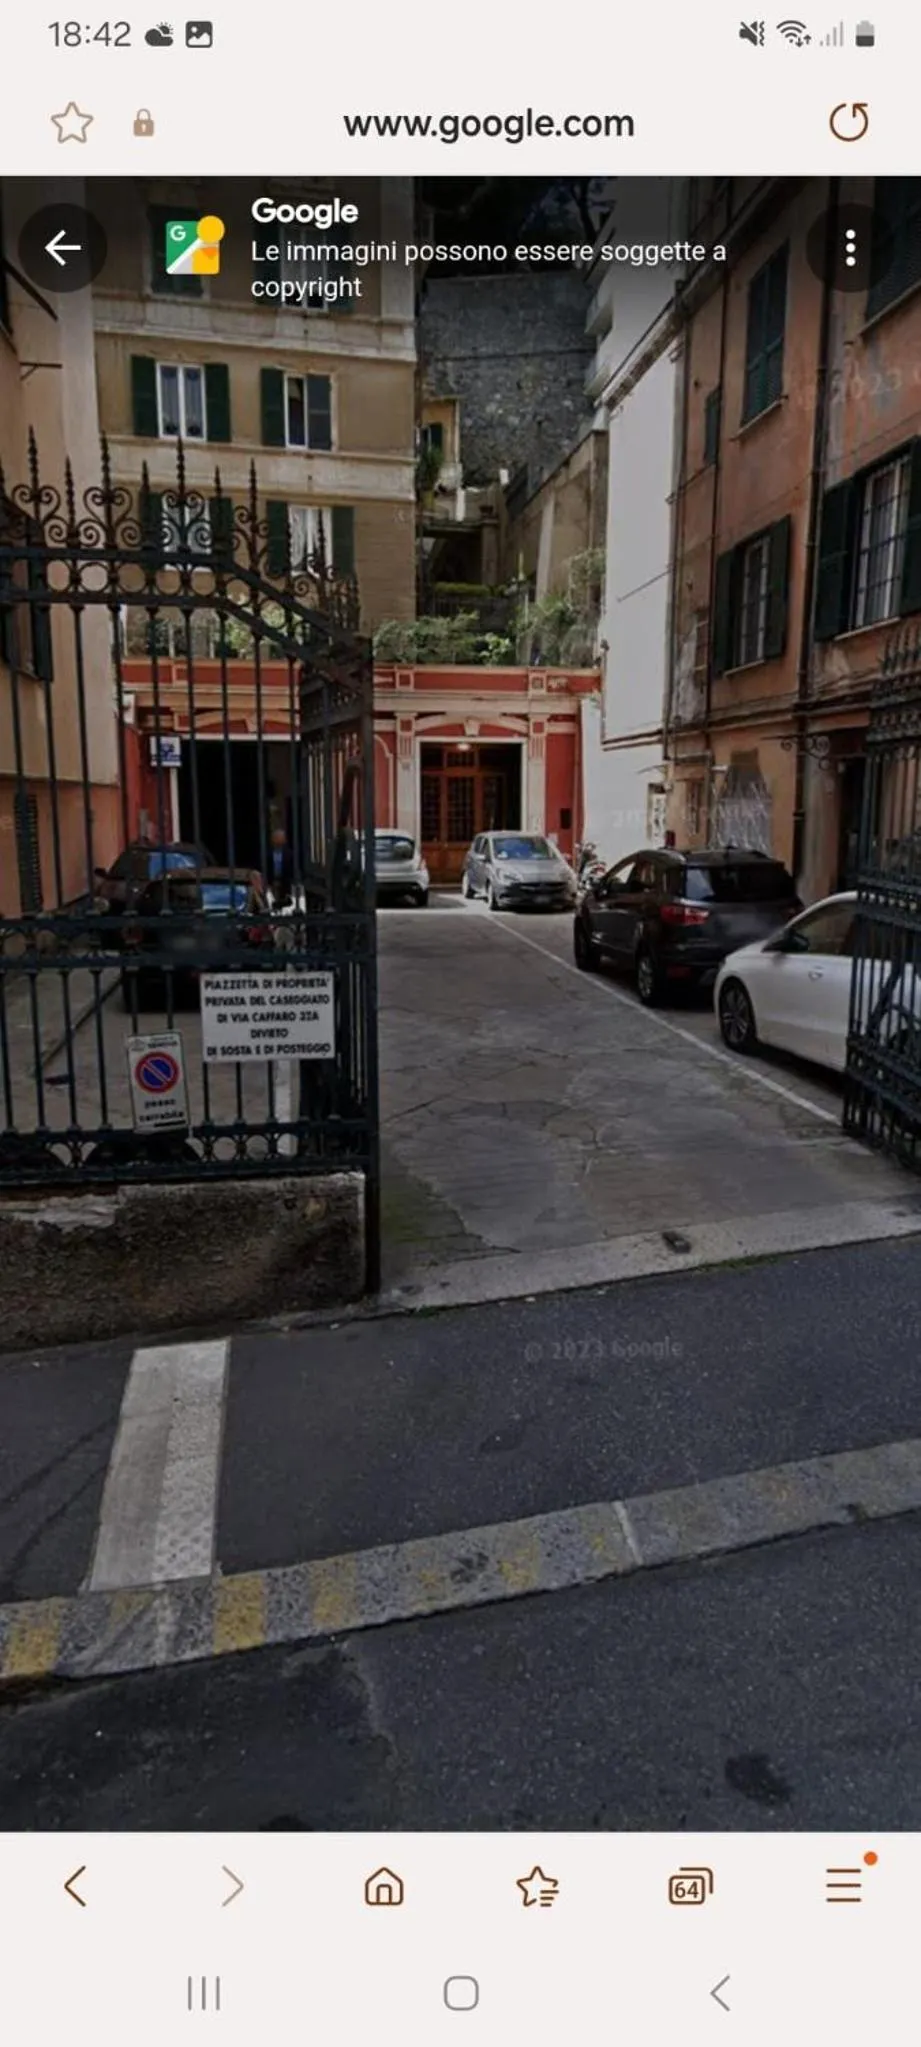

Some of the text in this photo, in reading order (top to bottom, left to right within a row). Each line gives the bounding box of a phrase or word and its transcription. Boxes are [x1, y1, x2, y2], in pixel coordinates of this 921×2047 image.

[49, 22, 131, 46] 18:42
[344, 108, 634, 145] www.google.com
[204, 978, 258, 990] PIAZZETTA
[263, 978, 273, 989] DI
[205, 995, 246, 1007] PRIVATA
[250, 995, 266, 1006] DEL
[217, 1013, 228, 1023] DI
[231, 1012, 249, 1023] VIA
[252, 1011, 297, 1022] CAFFARO
[250, 1028, 289, 1039] DIVIETO
[207, 1042, 331, 1056] DI SOSTA E DI POSTEGGIO
[675, 1881, 699, 1899] 64
